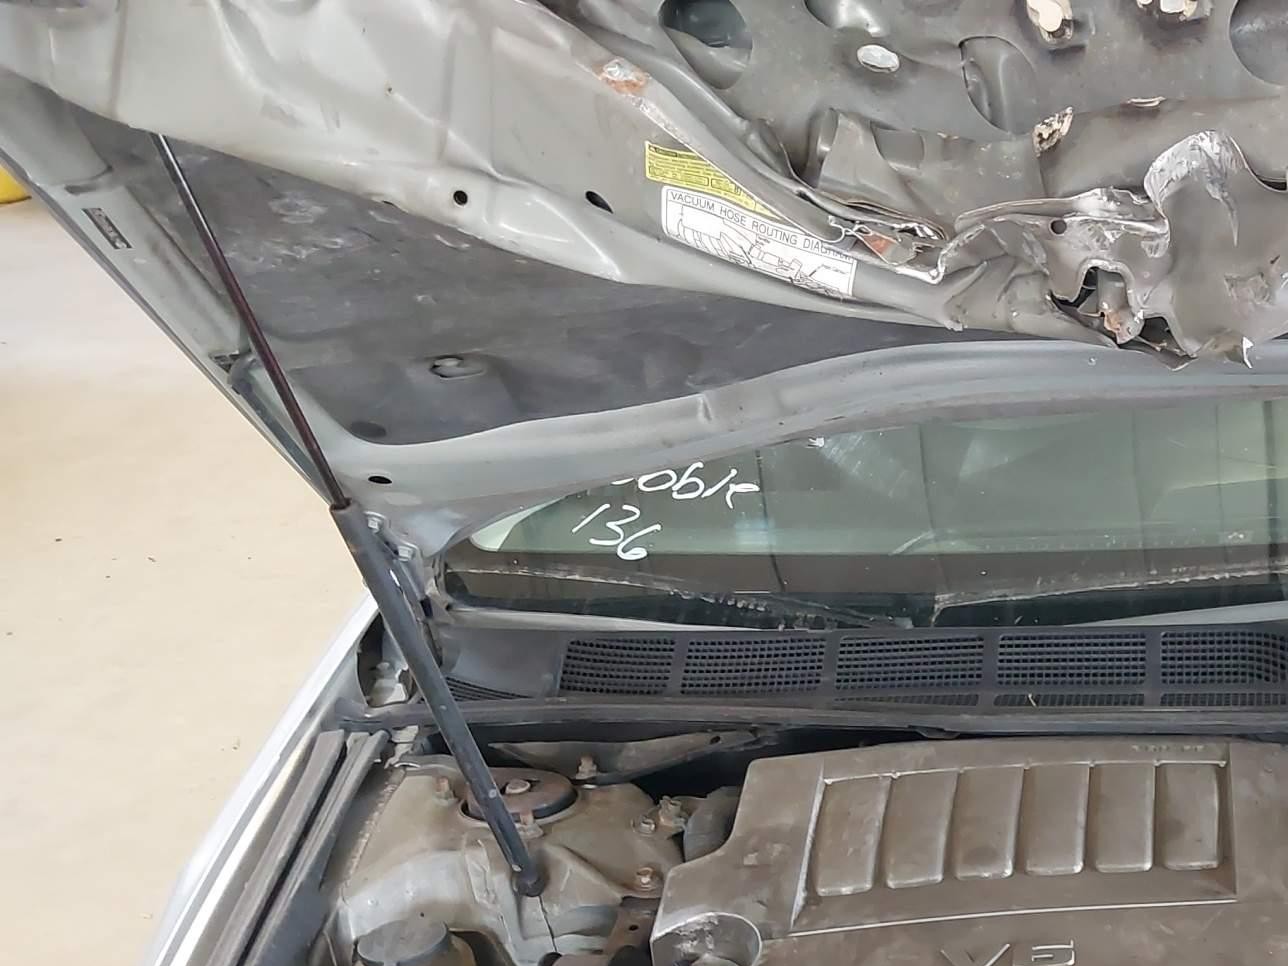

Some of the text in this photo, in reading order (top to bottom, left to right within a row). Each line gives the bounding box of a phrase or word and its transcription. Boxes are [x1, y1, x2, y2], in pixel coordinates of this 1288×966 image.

[670, 191, 715, 211] VACUUM
[720, 207, 747, 225] HOSE
[751, 220, 798, 245] ROUTING
[571, 503, 662, 560] 136
